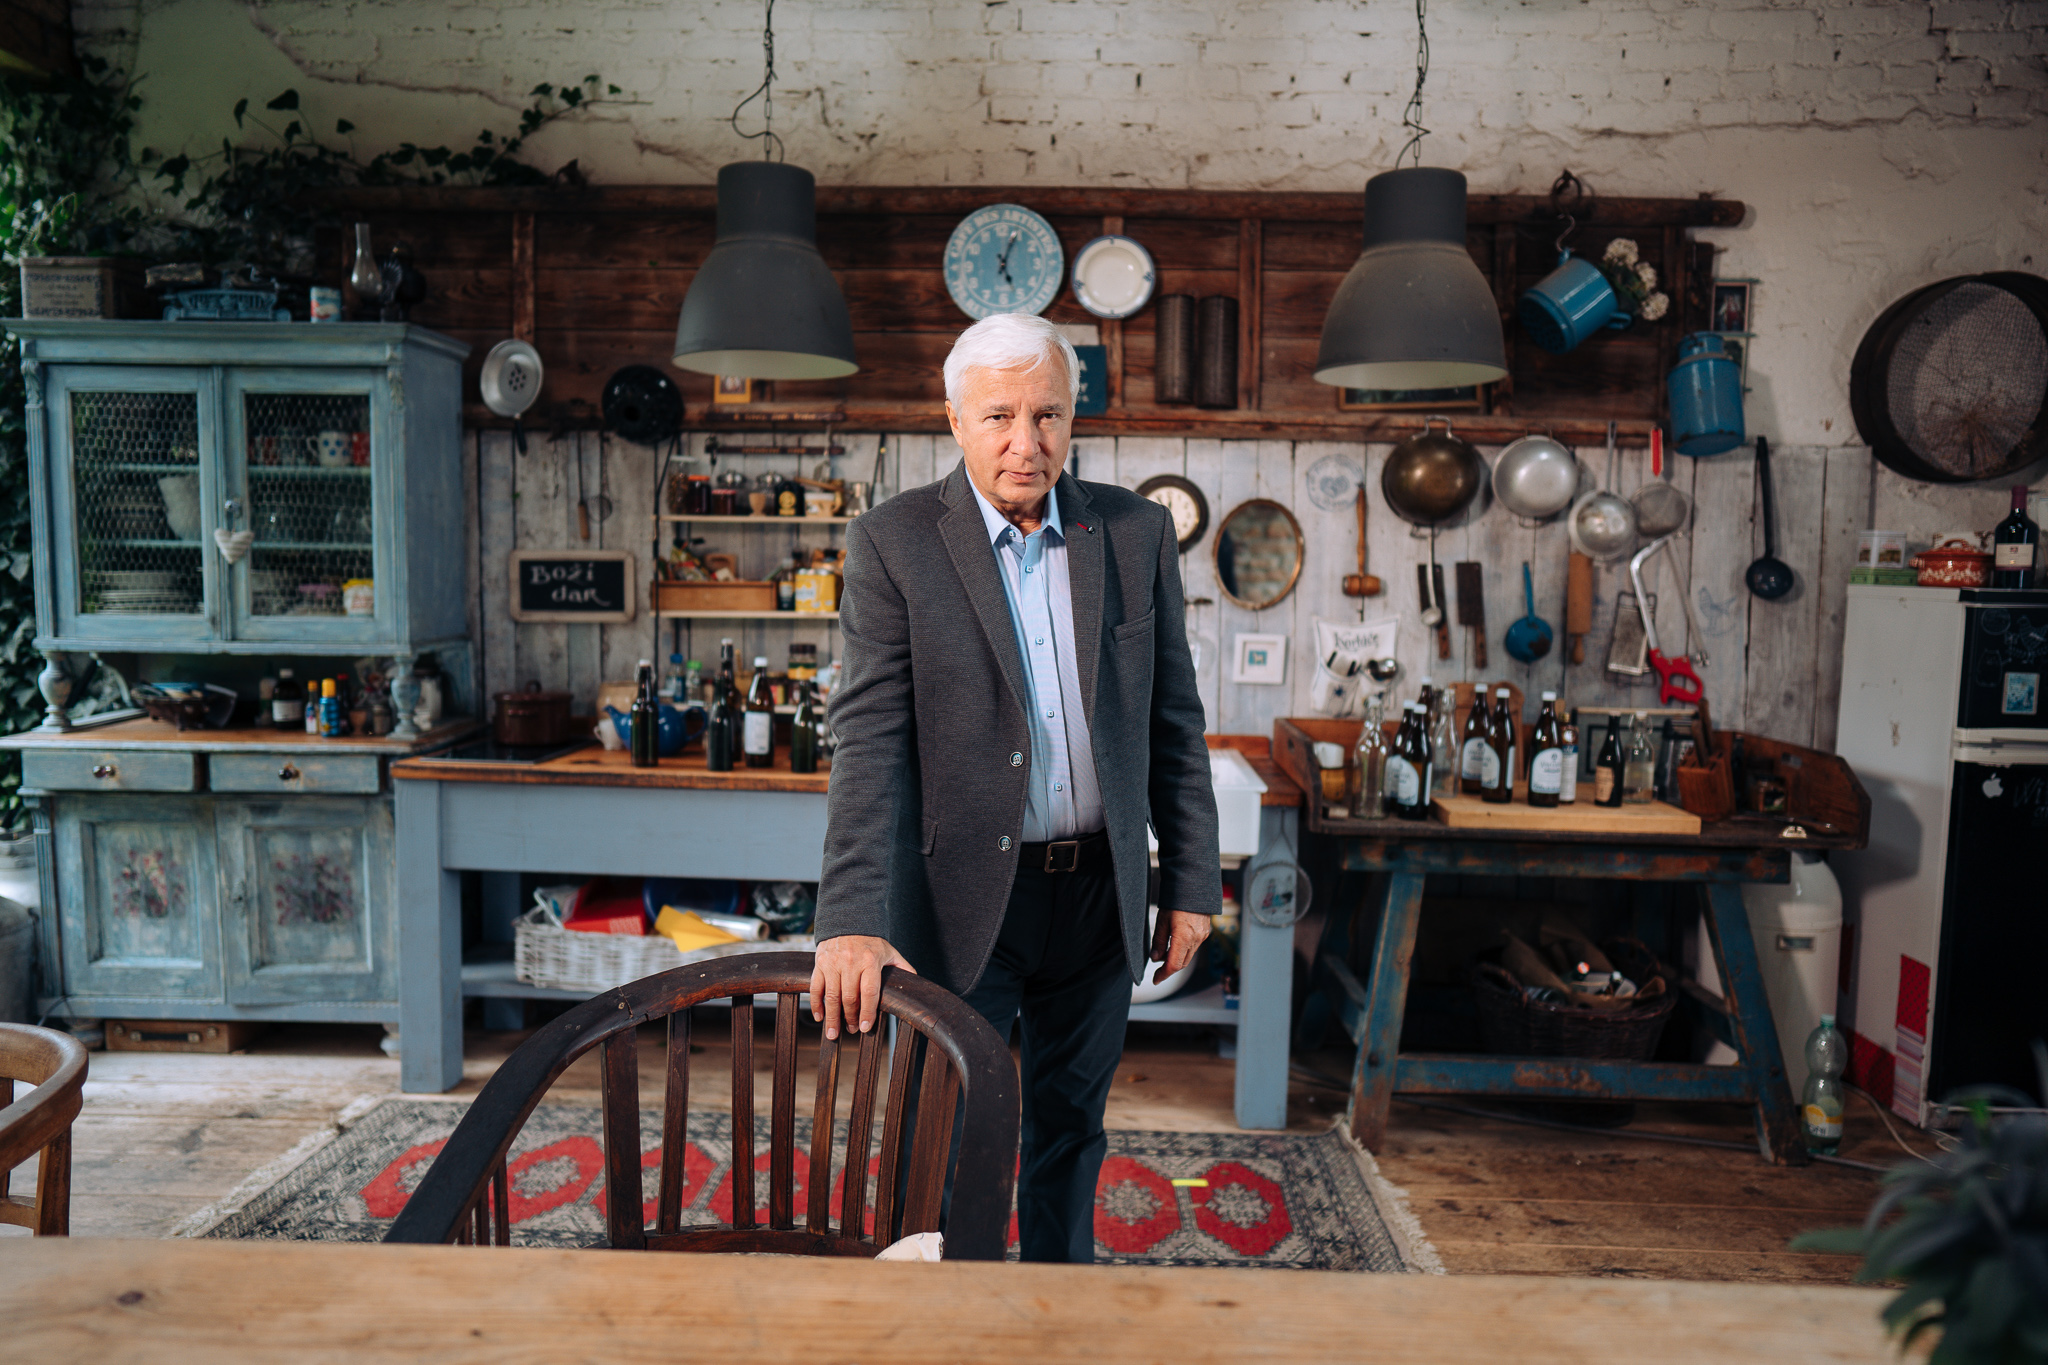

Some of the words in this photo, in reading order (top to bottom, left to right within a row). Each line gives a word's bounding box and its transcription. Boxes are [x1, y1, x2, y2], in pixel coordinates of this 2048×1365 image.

[973, 210, 1000, 227] DES
[1001, 209, 1058, 255] ARTISTES
[993, 225, 1009, 237] 12
[1027, 240, 1036, 252] 2
[964, 261, 974, 273] 9
[1032, 258, 1041, 270] 3
[1027, 276, 1036, 287] 4
[981, 290, 991, 301] 7
[999, 293, 1008, 305] 6
[1015, 288, 1025, 300] 5
